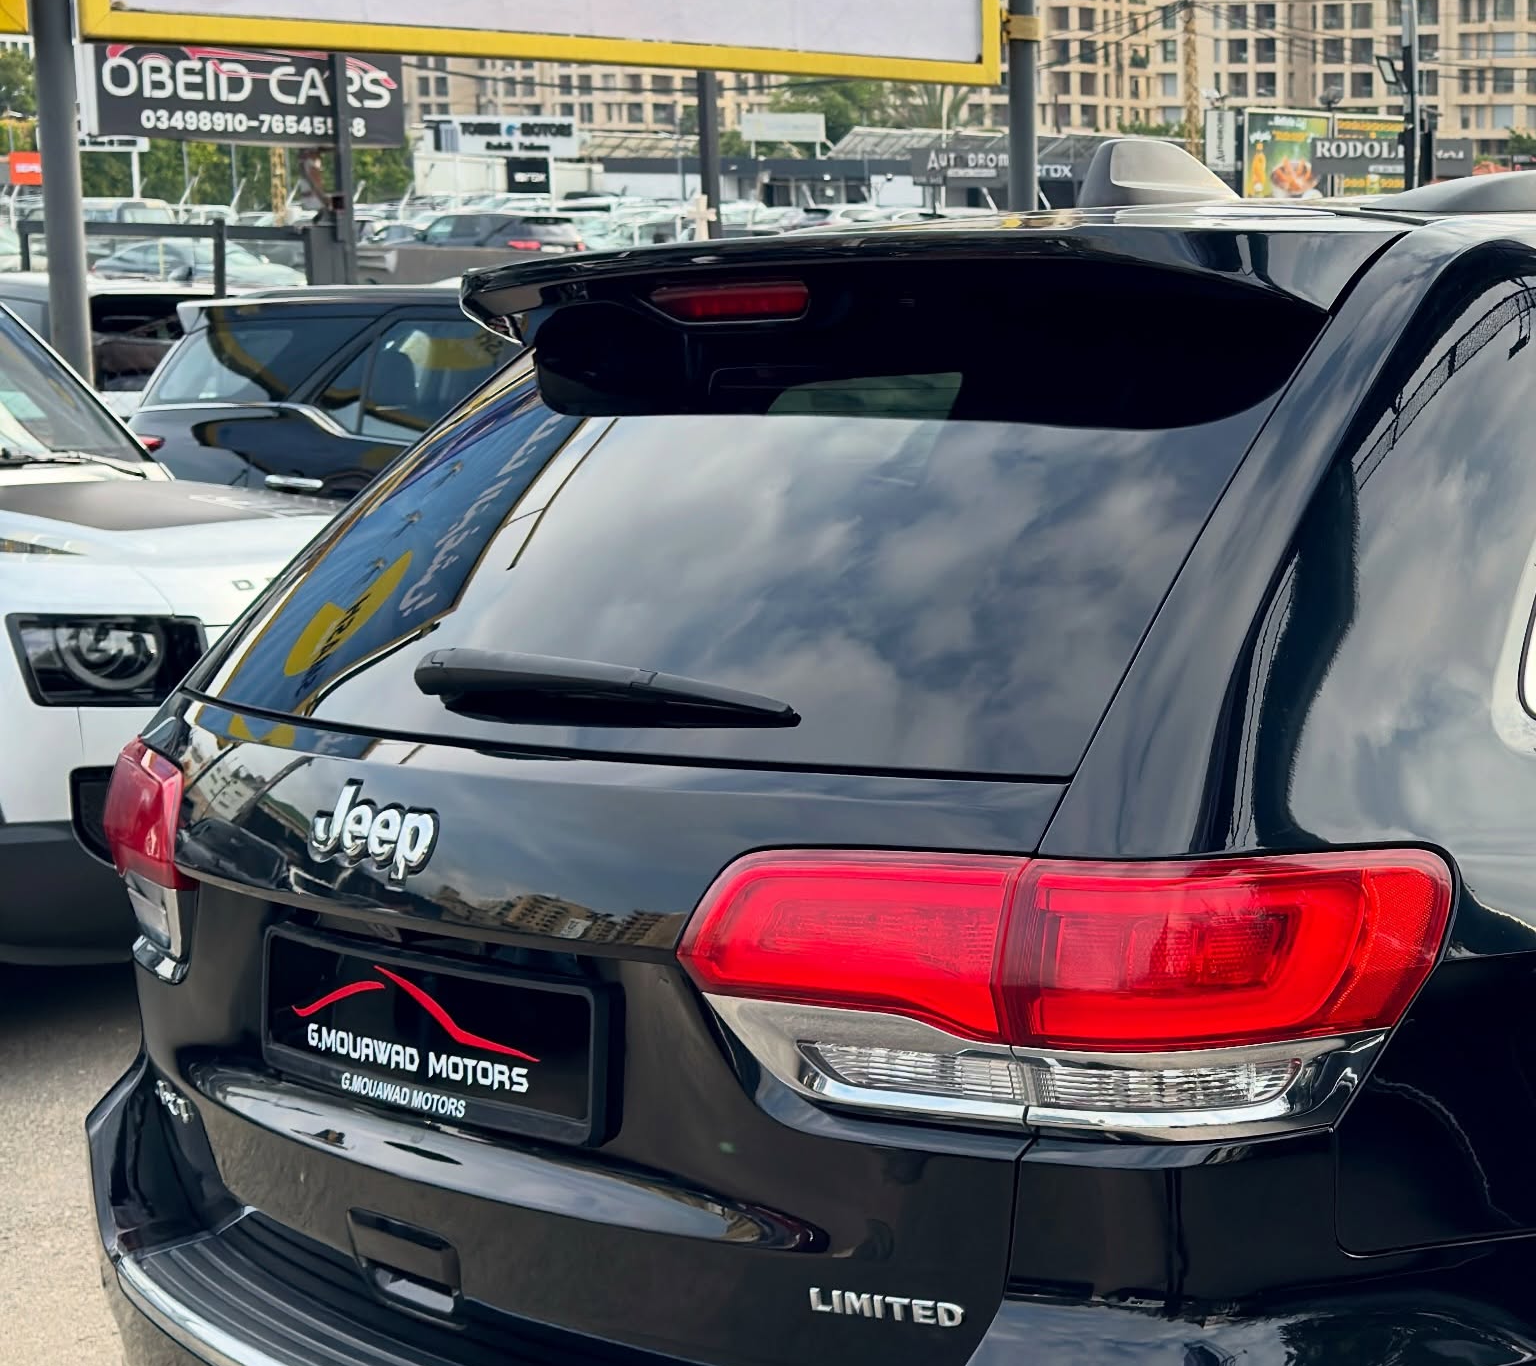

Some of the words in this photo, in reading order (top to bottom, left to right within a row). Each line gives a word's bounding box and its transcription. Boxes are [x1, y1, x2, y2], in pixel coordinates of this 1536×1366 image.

[102, 56, 253, 102] OBEID
[140, 108, 367, 138] 03498910-765458
[308, 778, 440, 890] Jeep
[306, 1022, 420, 1073] G.MOUAWAD
[427, 1050, 530, 1094] MOTORS
[340, 1071, 411, 1106] G.MOUAWAD
[411, 1088, 467, 1119] MOTORS
[808, 1287, 965, 1328] LIMITED
